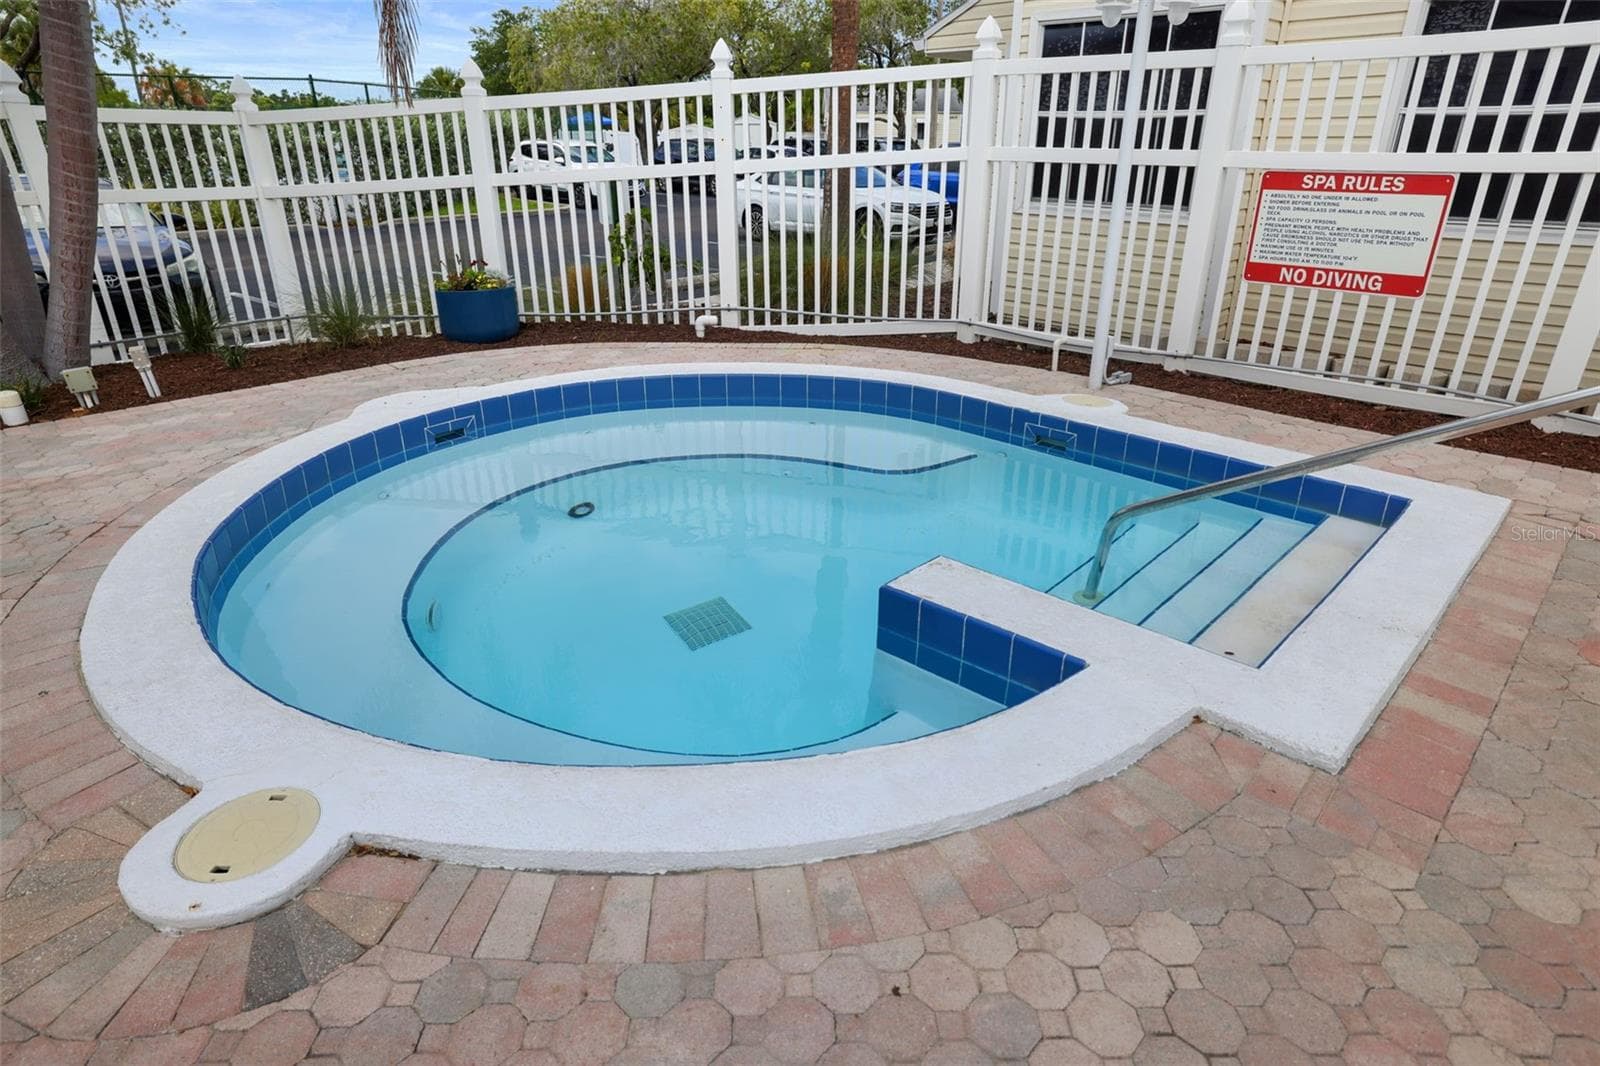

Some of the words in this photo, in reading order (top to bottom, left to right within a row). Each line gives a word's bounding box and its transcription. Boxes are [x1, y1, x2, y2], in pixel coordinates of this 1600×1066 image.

[1301, 174, 1336, 190] SPA
[1342, 175, 1406, 192] RULES
[1279, 267, 1307, 284] NO
[1312, 271, 1383, 291] DIVING
